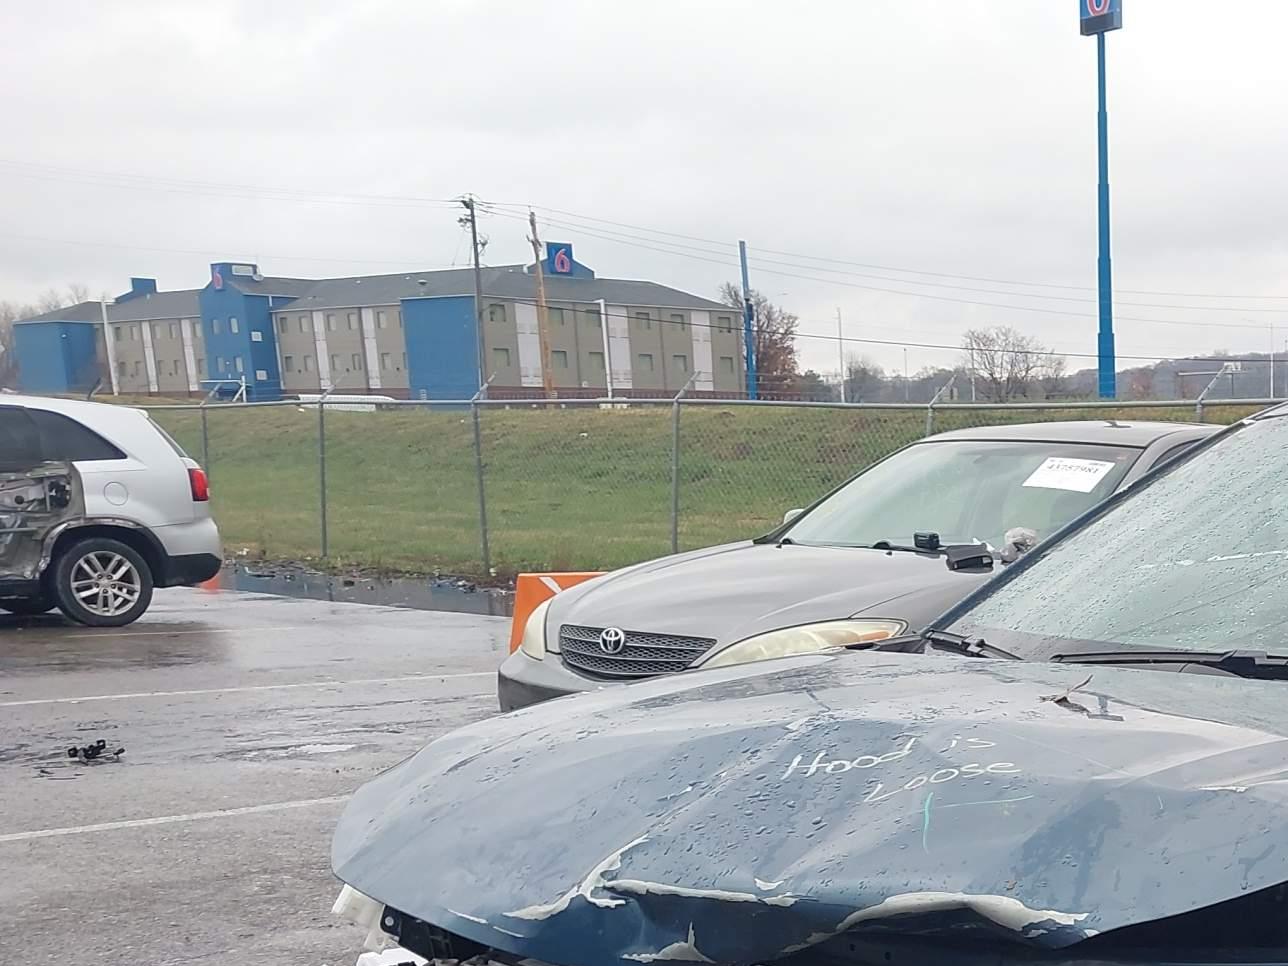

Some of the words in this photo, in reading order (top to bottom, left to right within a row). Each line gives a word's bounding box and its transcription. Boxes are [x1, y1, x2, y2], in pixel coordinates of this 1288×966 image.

[555, 248, 570, 273] 6
[781, 737, 917, 780] Hood
[949, 736, 996, 749] is
[864, 760, 1022, 802] Loose
